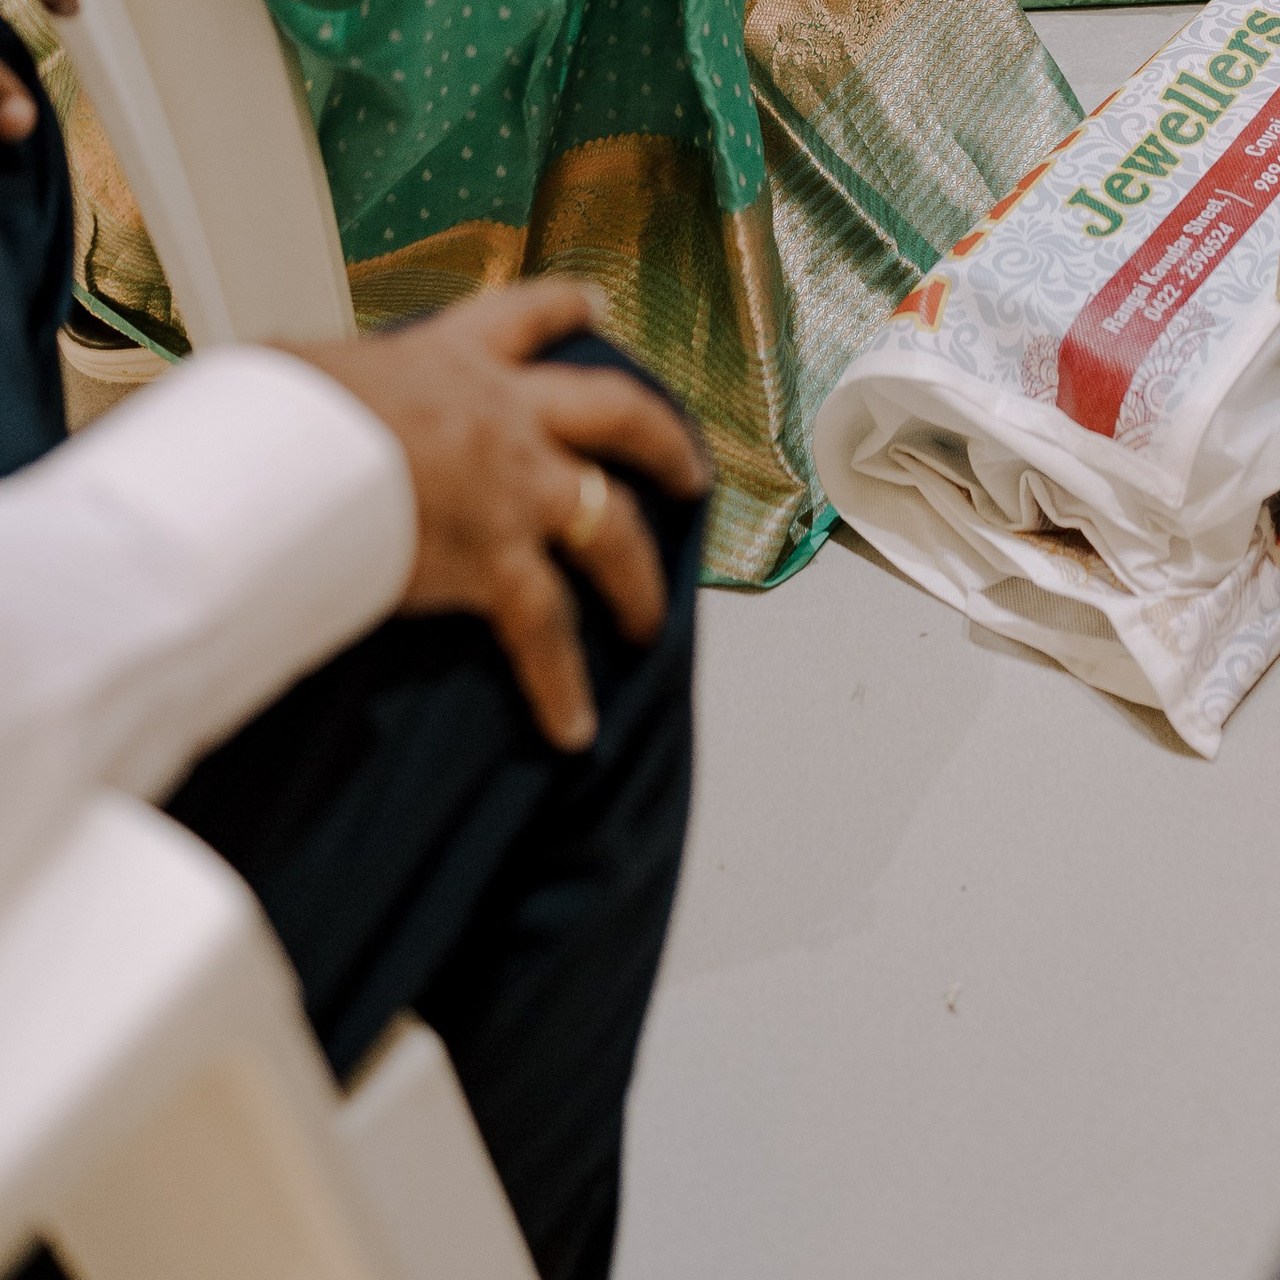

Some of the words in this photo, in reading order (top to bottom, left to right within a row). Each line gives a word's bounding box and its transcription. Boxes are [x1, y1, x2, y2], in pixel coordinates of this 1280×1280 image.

[1100, 281, 1153, 335] Rangai
[1143, 283, 1183, 321] 0422
[1180, 221, 1236, 280] 2396524
